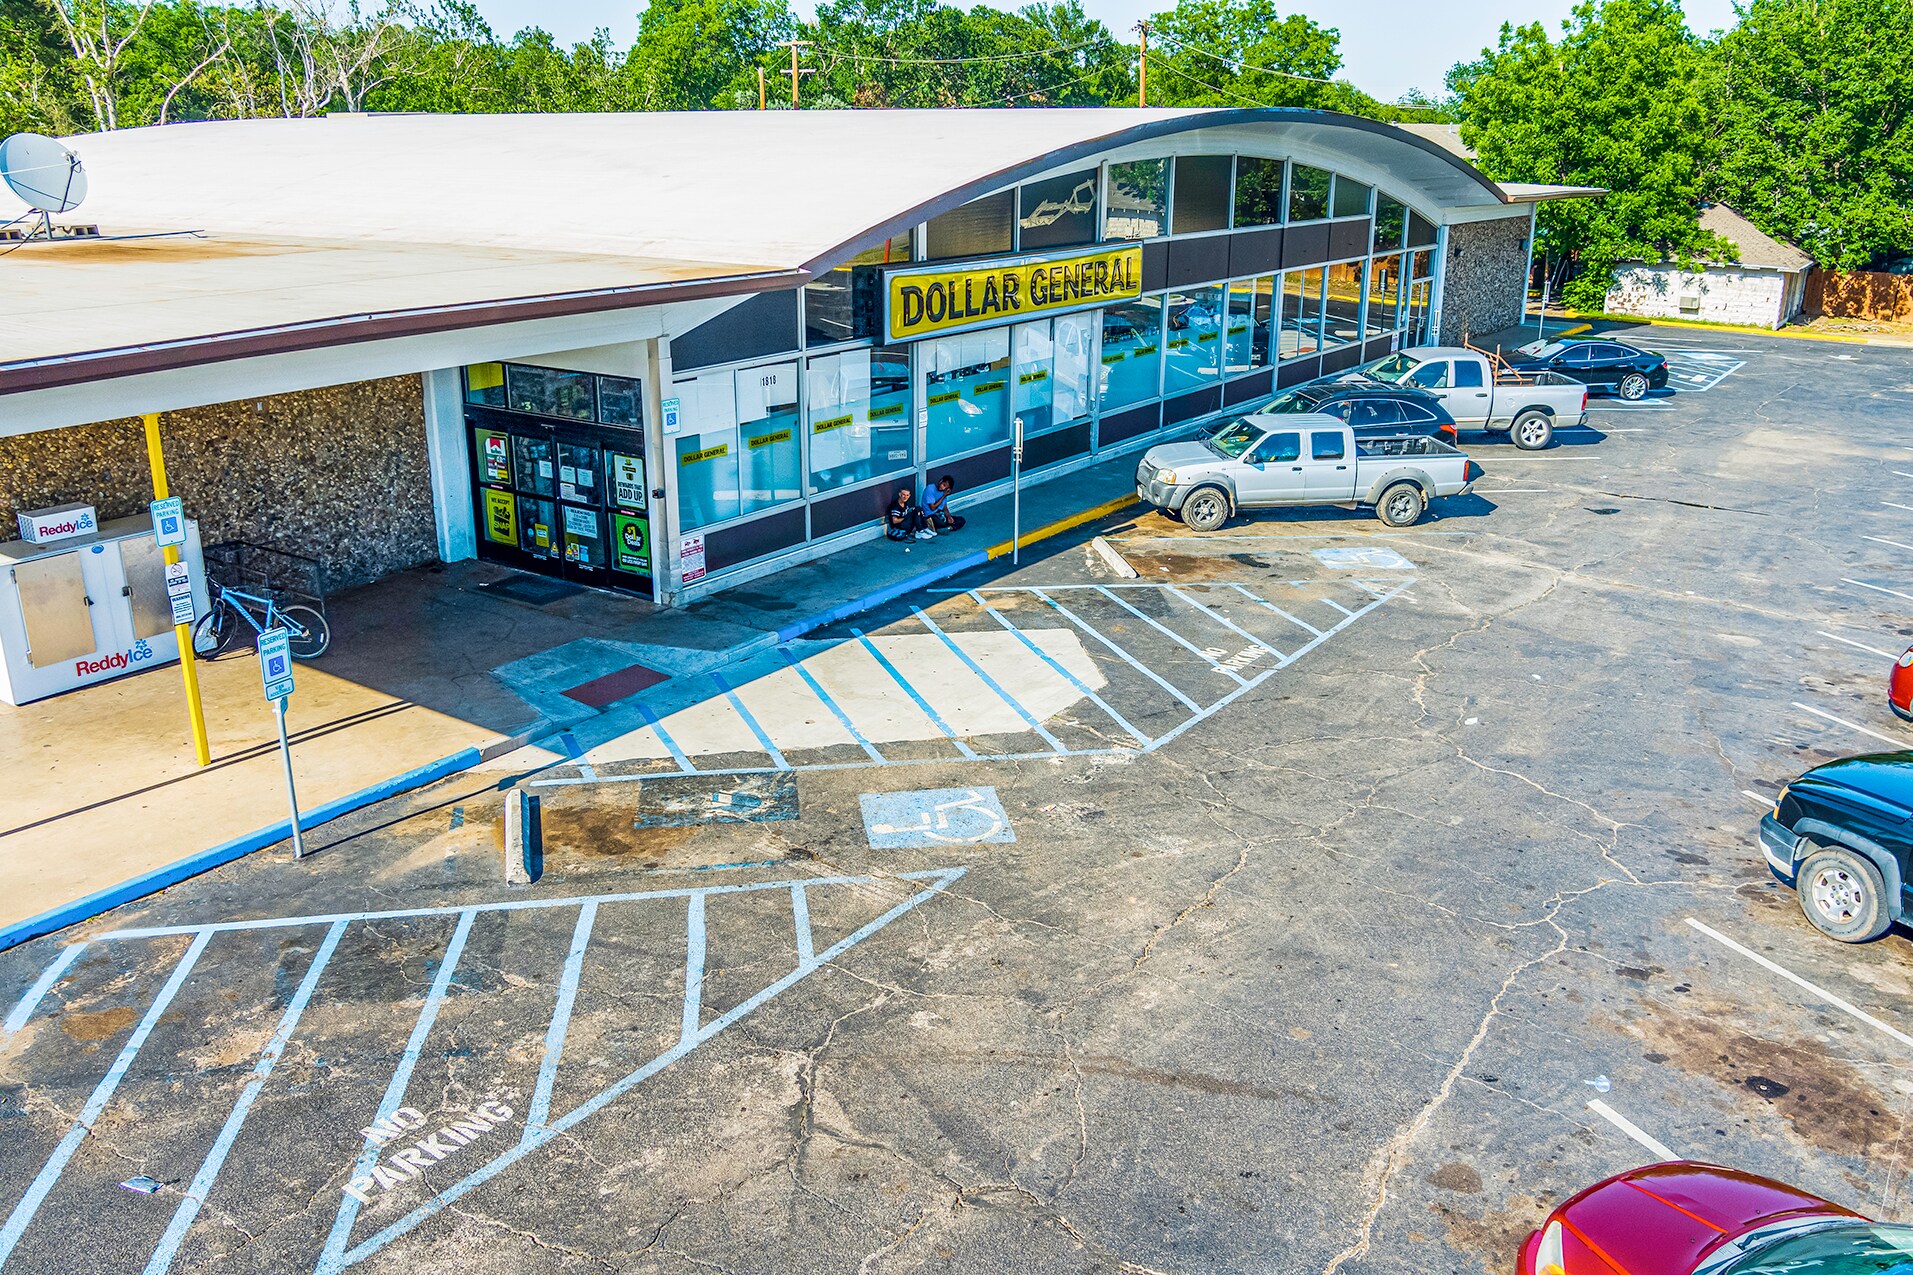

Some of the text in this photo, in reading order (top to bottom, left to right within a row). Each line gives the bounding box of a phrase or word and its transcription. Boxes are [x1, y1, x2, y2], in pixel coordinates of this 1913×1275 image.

[900, 256, 1137, 327] DOLLAR GENERAL
[762, 375, 776, 386] 1818
[816, 417, 851, 431] DOLLAR GENERAL
[751, 432, 789, 446] DOLLAR GENERAL
[683, 447, 726, 463] DOLLAR GENERAL
[619, 488, 643, 503] ADD UP.
[153, 500, 180, 510] RESERVED
[156, 508, 179, 517] PARKING
[493, 520, 510, 530] SNAP
[260, 633, 286, 646] RESERVED
[263, 643, 286, 656] PARKING
[358, 1107, 428, 1145] NO
[341, 1100, 514, 1206] PARKING
